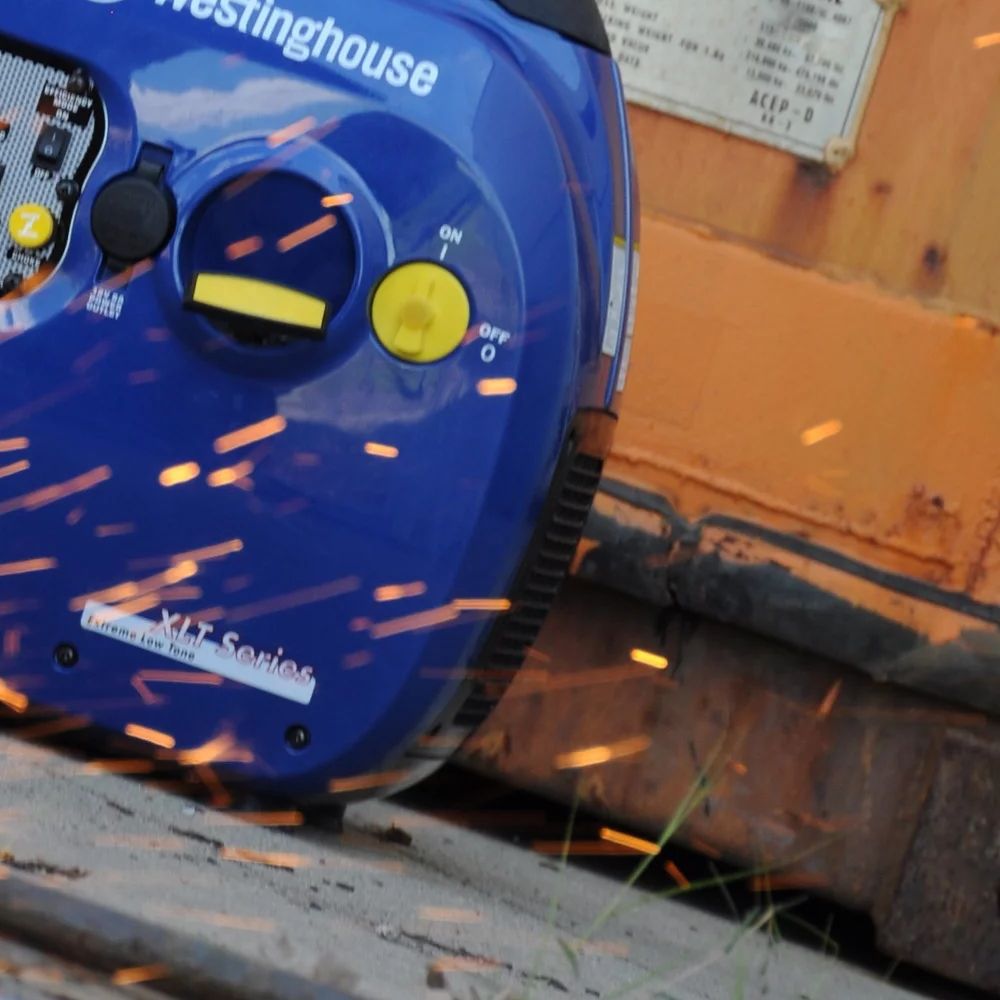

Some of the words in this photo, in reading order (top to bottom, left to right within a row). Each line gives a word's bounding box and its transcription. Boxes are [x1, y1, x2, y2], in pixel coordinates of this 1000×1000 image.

[439, 224, 463, 246] ON
[479, 322, 511, 346] OFF
[140, 628, 165, 650] Low
[152, 608, 213, 648] XLT
[216, 631, 313, 686] Series
